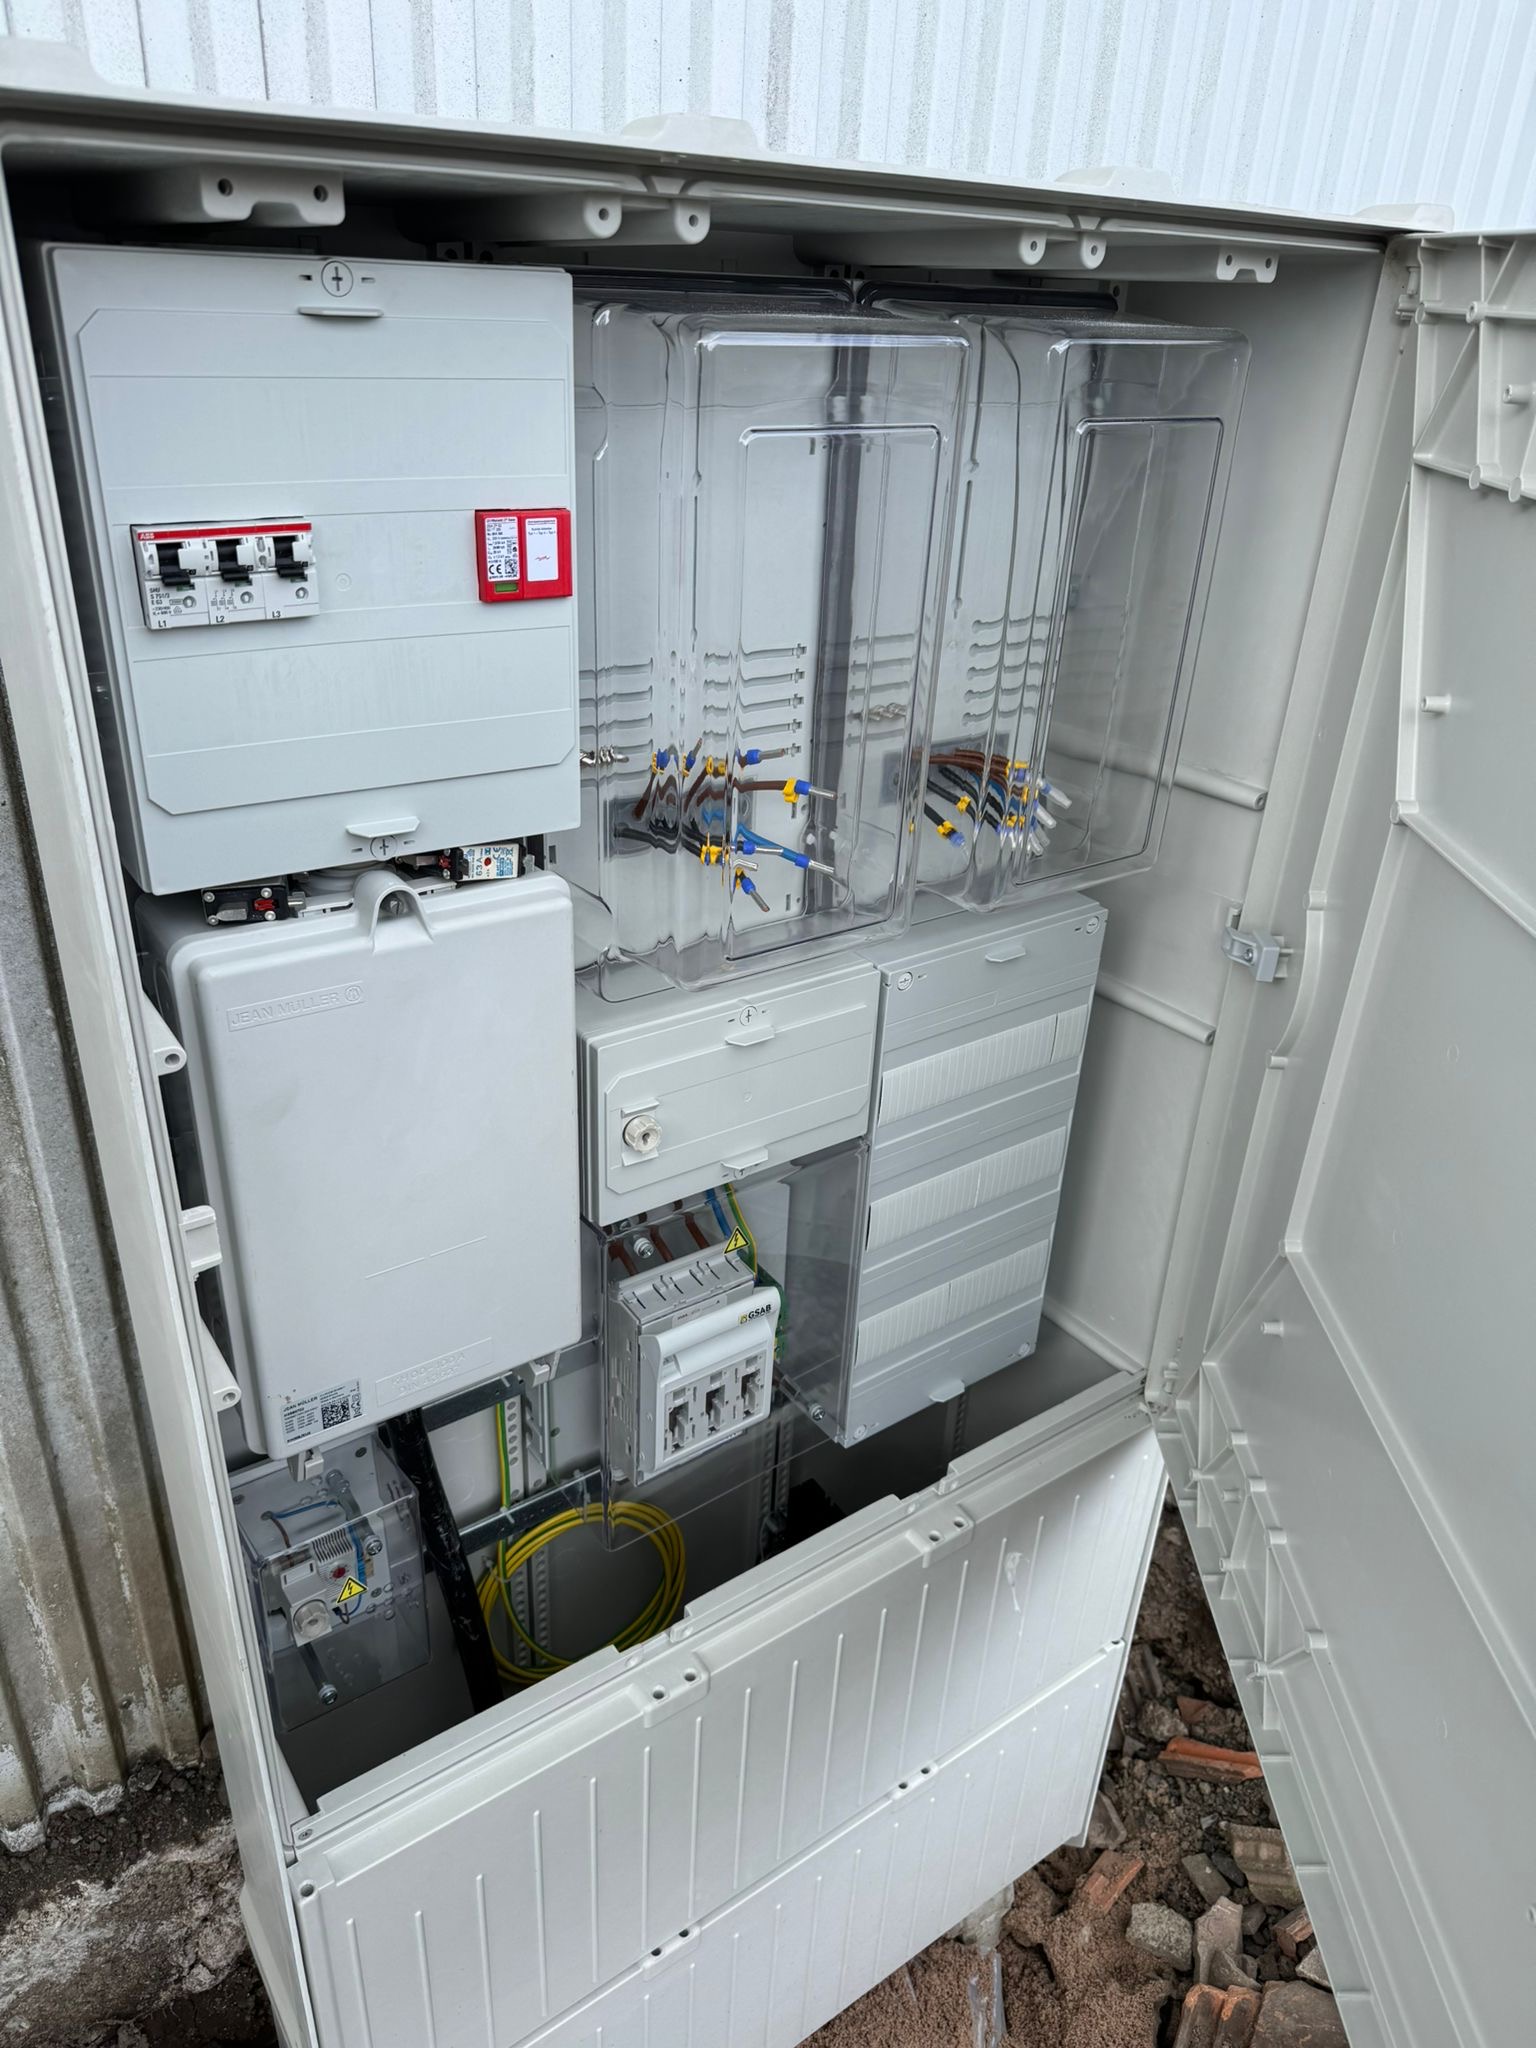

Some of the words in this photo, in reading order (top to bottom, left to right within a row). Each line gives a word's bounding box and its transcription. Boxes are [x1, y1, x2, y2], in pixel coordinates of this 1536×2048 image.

[139, 532, 155, 540] ABB
[216, 615, 225, 623] L2
[231, 1007, 273, 1027] JEAN
[748, 1303, 772, 1320] GSAB
